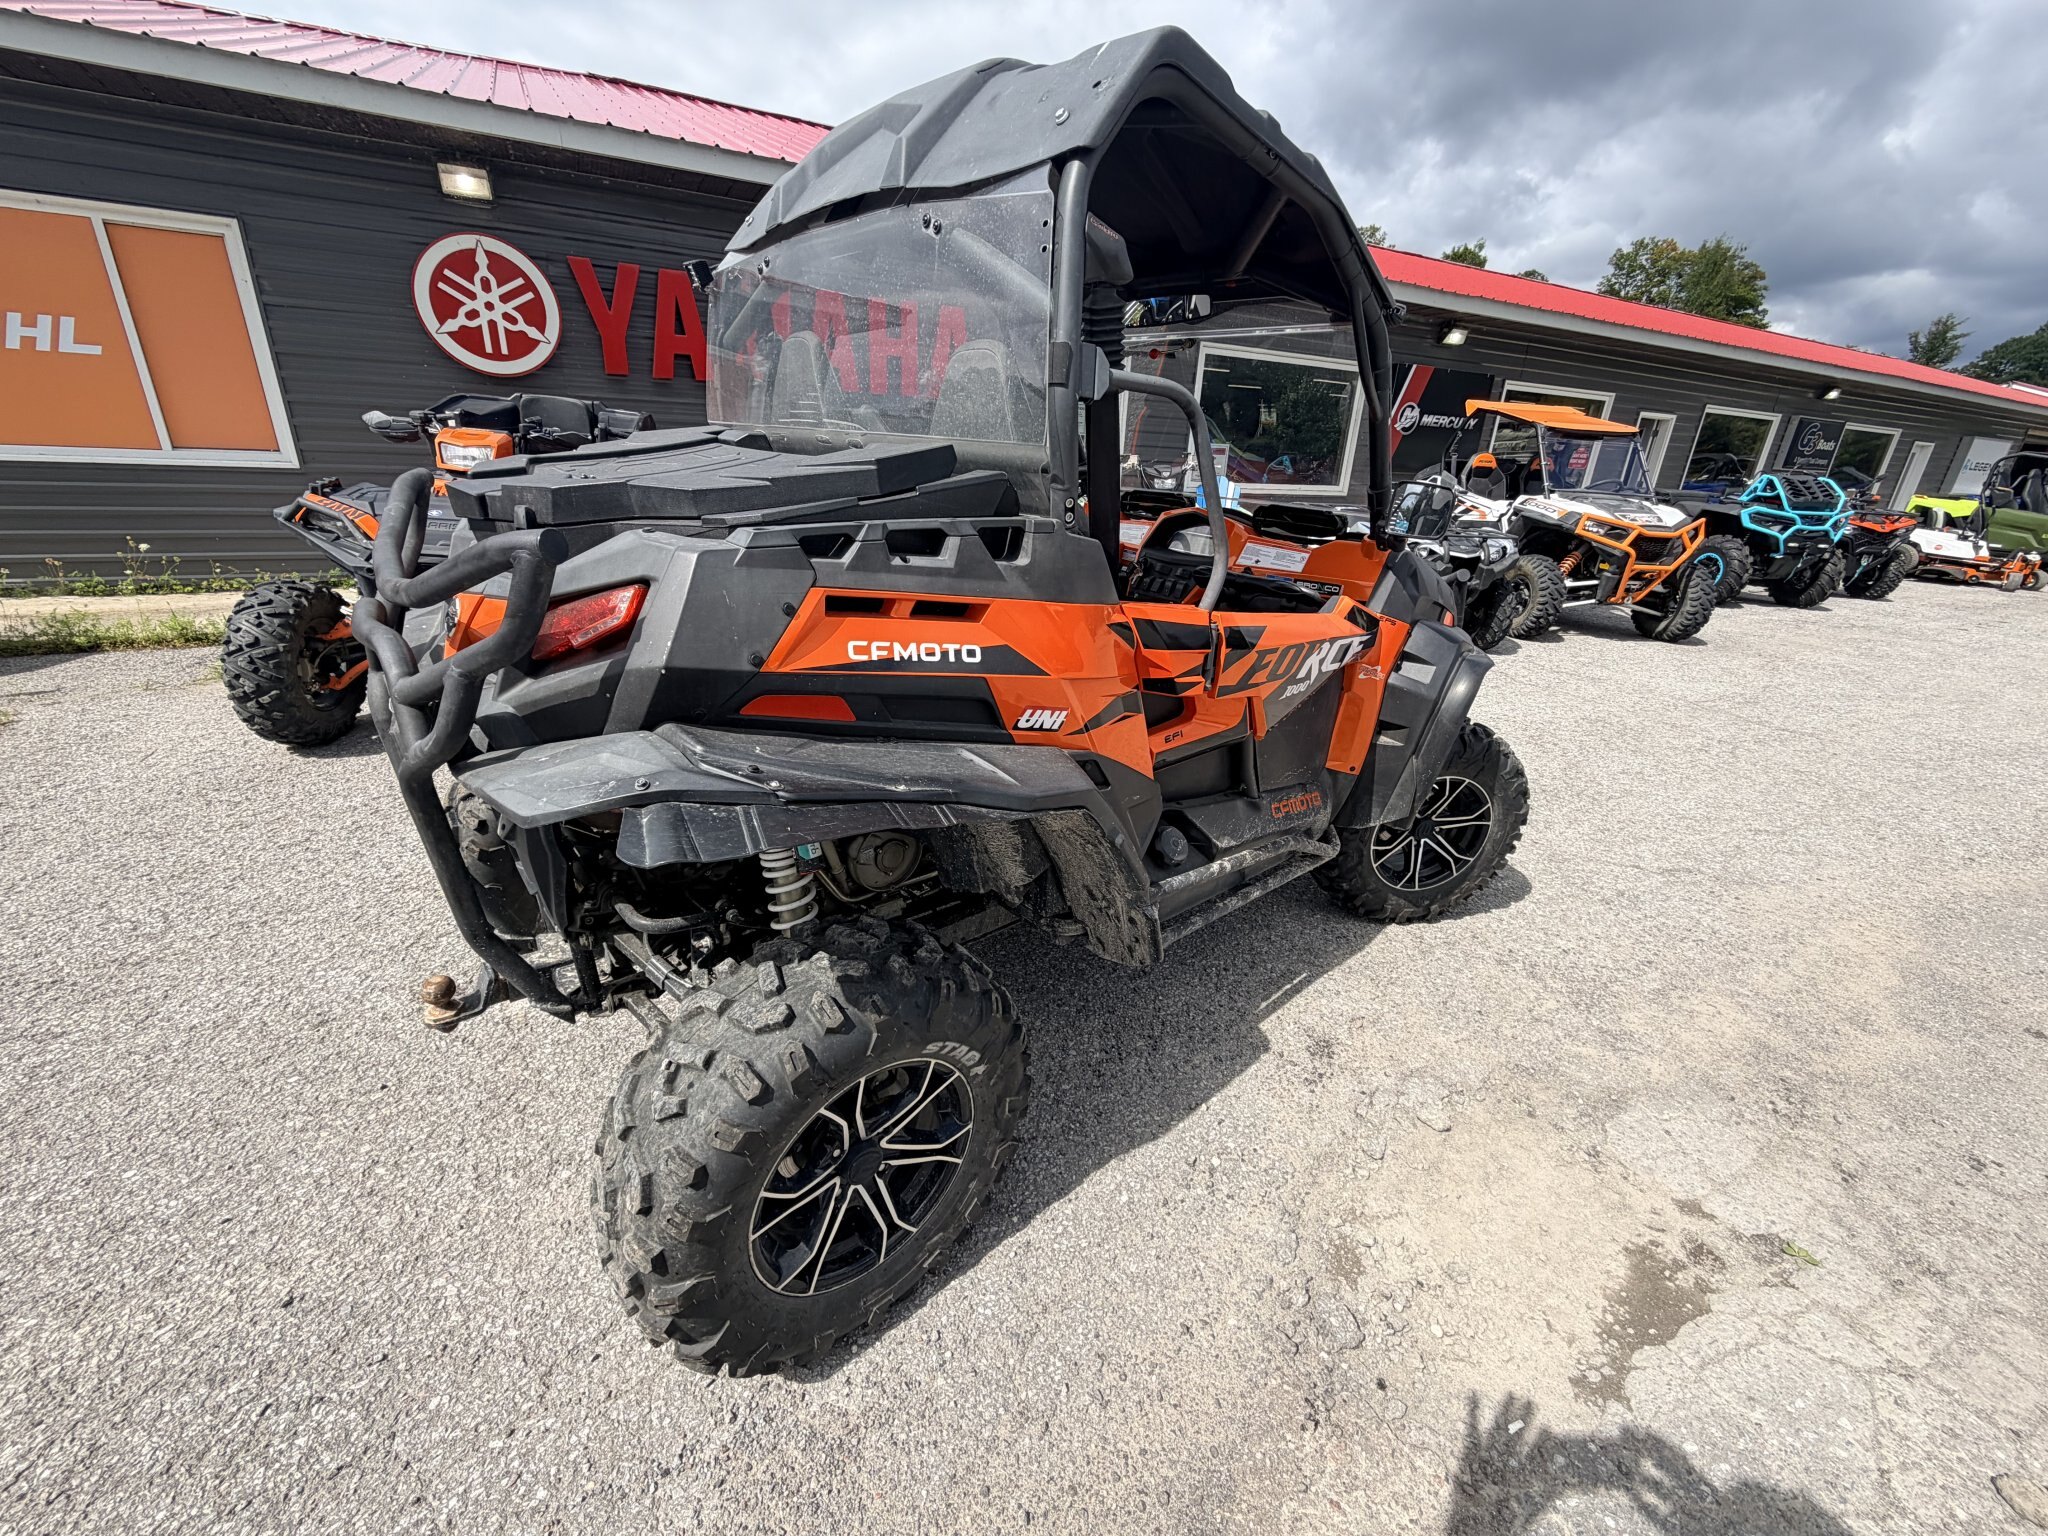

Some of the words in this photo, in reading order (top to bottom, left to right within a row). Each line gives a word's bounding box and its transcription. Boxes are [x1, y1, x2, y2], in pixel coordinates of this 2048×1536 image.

[5, 311, 102, 355] HL
[1815, 439, 1836, 451] Boats
[1296, 581, 1340, 593] BRONCO
[1380, 615, 1397, 627] EPS
[847, 640, 982, 663] CFMOTO
[1279, 680, 1310, 700] 1000
[1164, 730, 1184, 744] EFI
[1271, 791, 1321, 818] CFMOTO
